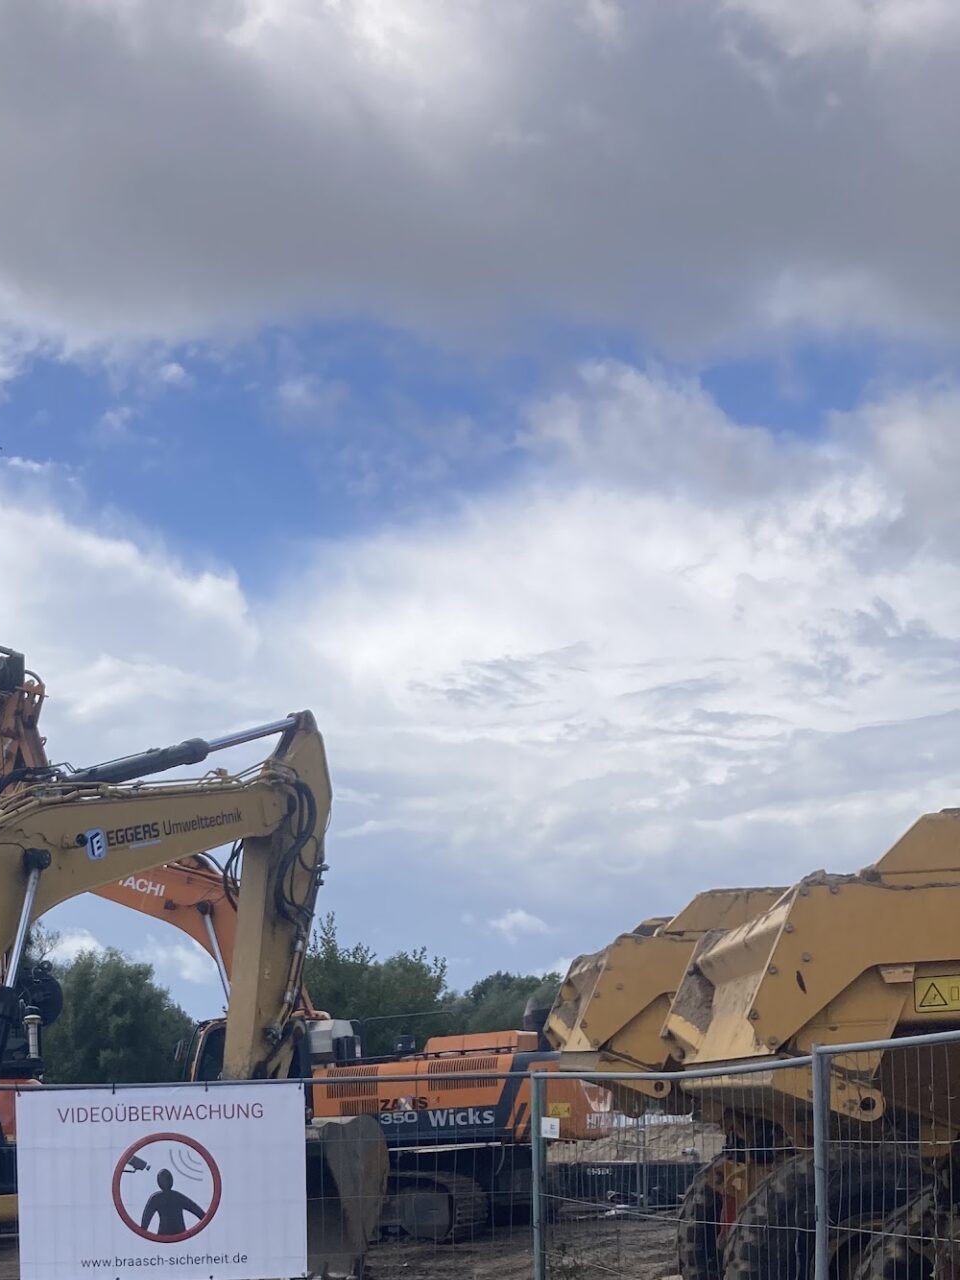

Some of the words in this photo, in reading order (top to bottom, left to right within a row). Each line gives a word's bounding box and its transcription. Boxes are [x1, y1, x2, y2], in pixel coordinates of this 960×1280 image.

[106, 822, 160, 847] EGGERS
[162, 808, 242, 836] Umwelttechnik
[57, 1102, 264, 1124] VIDEOÜBERWACHUNG
[380, 1111, 418, 1125] 350
[427, 1107, 495, 1128] Wicks
[81, 1252, 248, 1269] www.braasch-sicherheit.de
